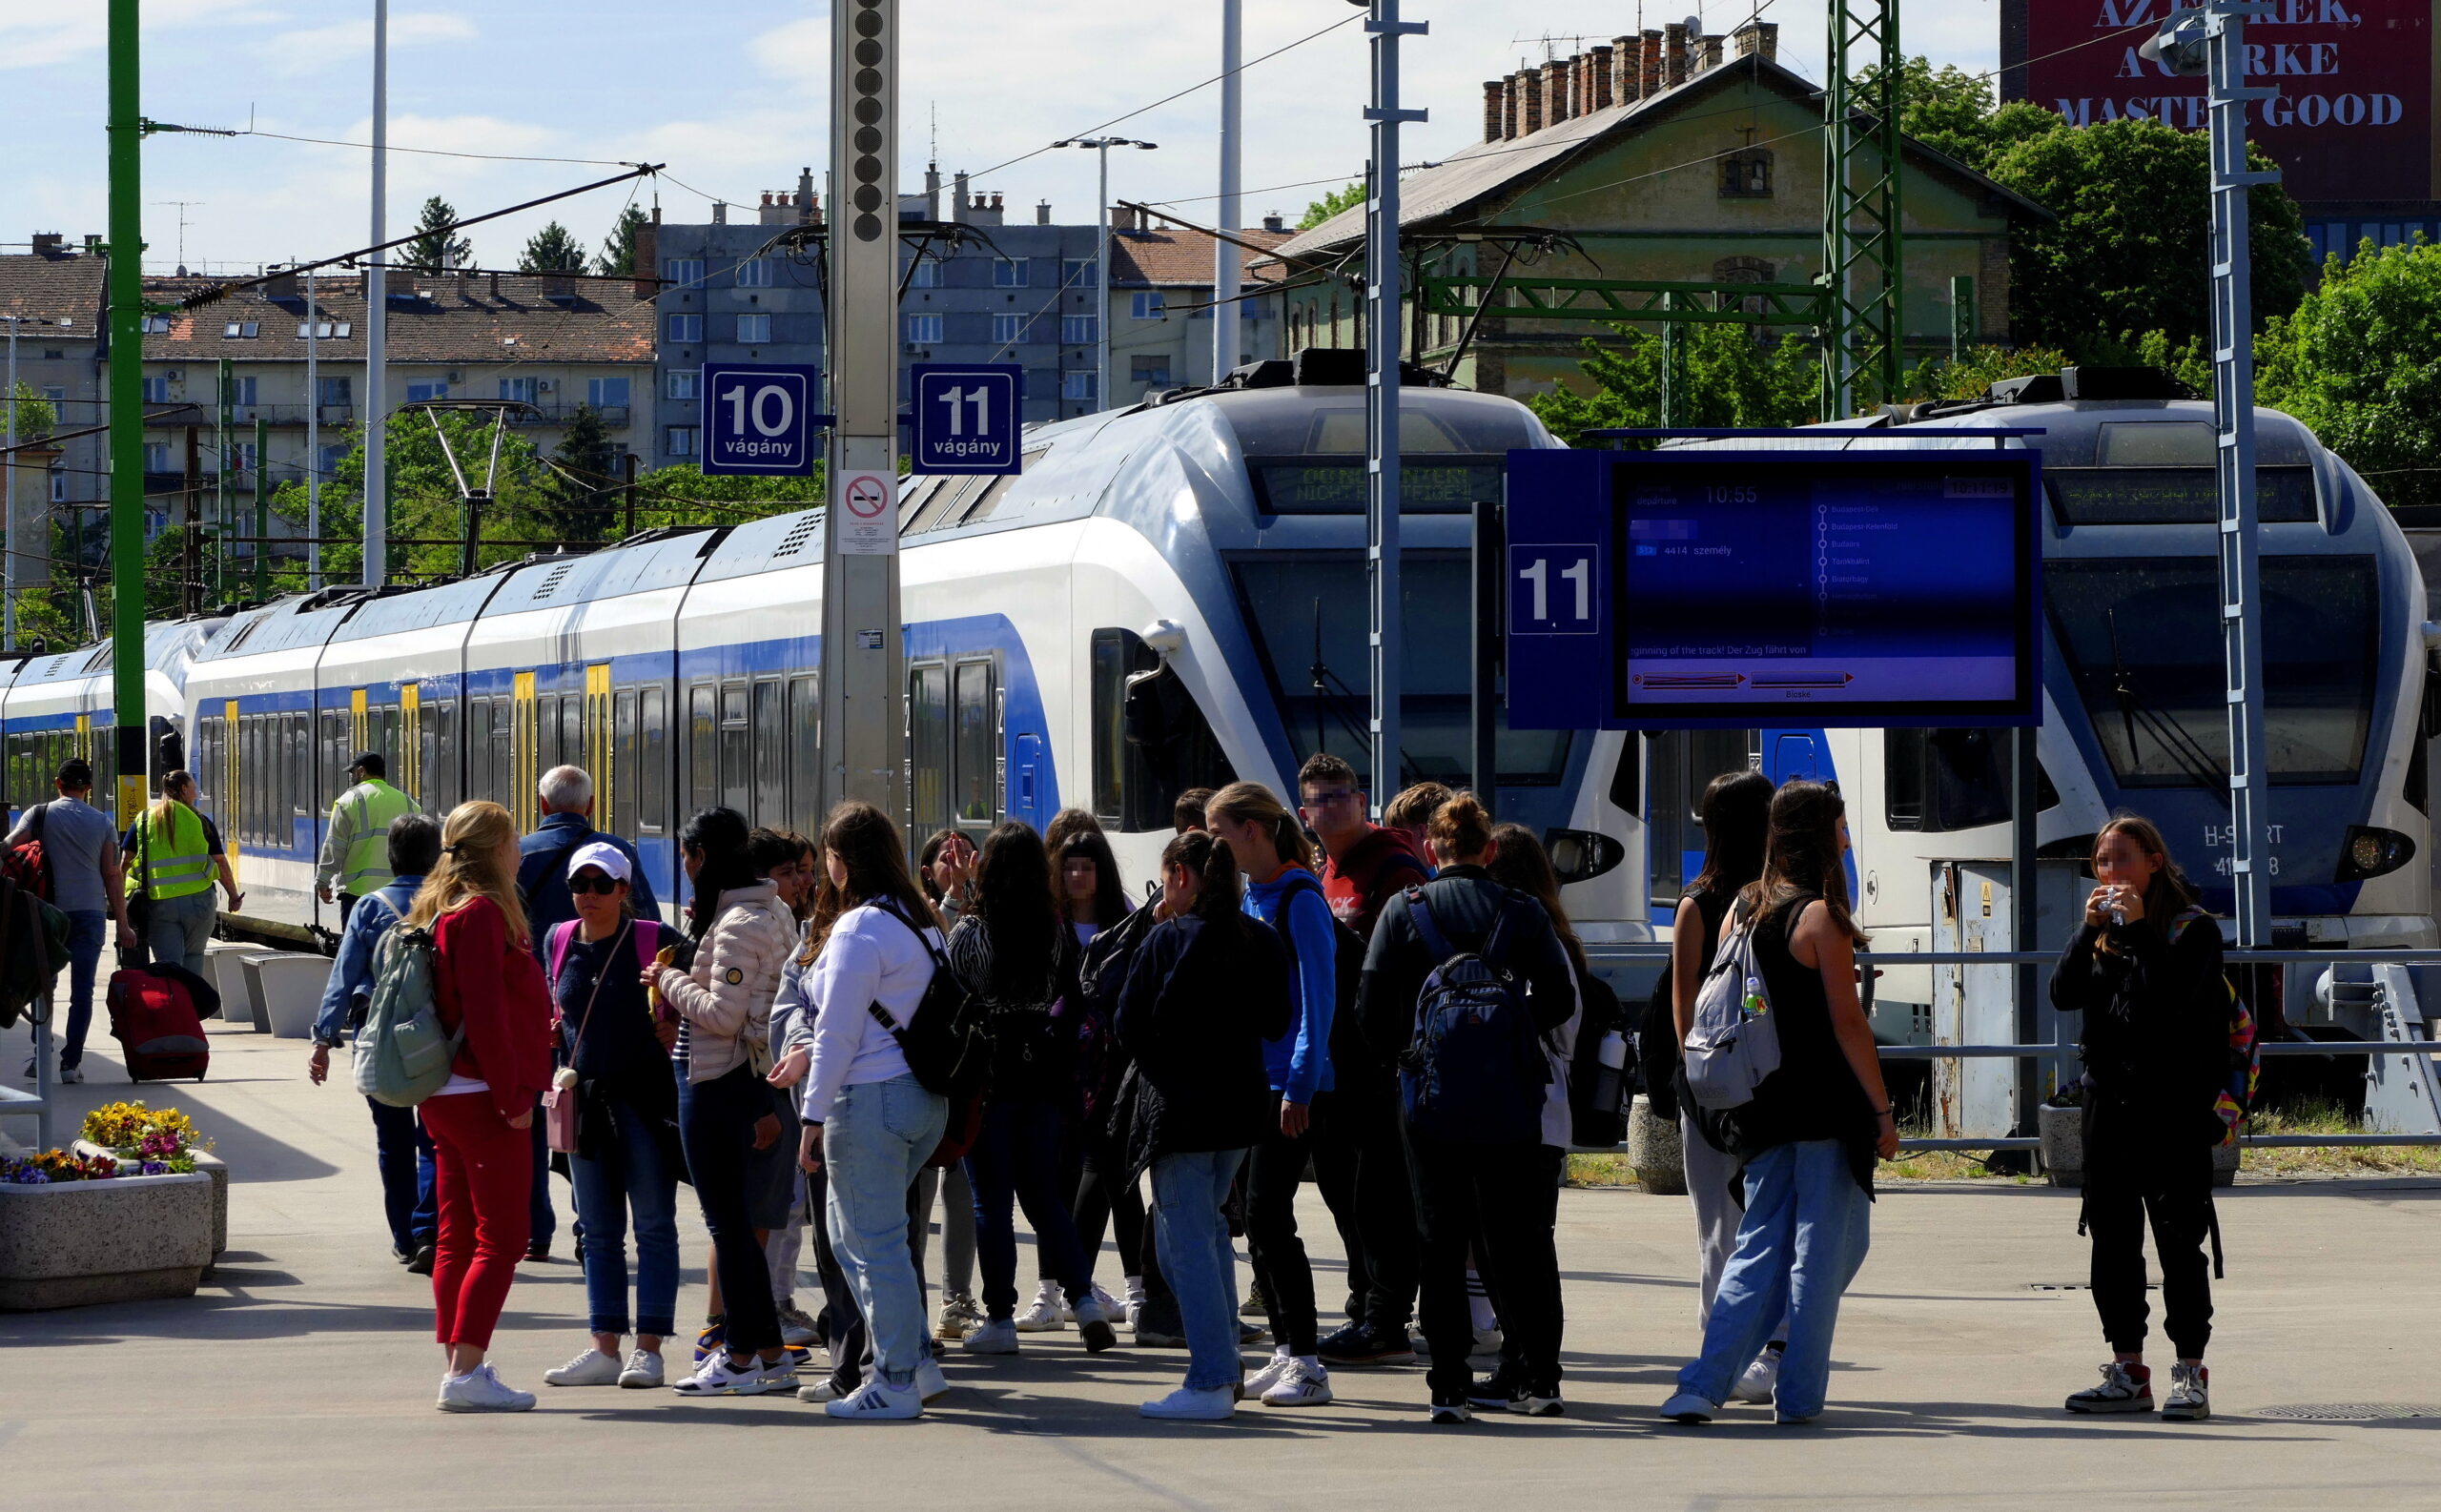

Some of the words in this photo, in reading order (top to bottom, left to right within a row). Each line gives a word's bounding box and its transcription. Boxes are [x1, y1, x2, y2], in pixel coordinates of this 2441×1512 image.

[2092, 0, 2155, 27] AZ
[2115, 46, 2145, 78] A
[2054, 95, 2251, 129] MASTE
[2262, 92, 2403, 128] GOOD
[721, 384, 793, 438] 10
[937, 385, 989, 436] 11
[725, 438, 793, 458] vágány
[933, 439, 1001, 458] vágány
[1706, 485, 1757, 503] 10:55
[1664, 545, 1688, 556] 4414
[1693, 544, 1732, 557] személy
[1519, 558, 1590, 621] 11
[1671, 644, 1679, 655] of
[1682, 644, 1696, 655] the
[1699, 644, 1725, 656] track!
[1728, 644, 1743, 655] Der
[1746, 644, 1763, 657] Zug
[1765, 644, 1787, 655] fährt
[1790, 646, 1807, 655] von
[997, 694, 1004, 734] 2
